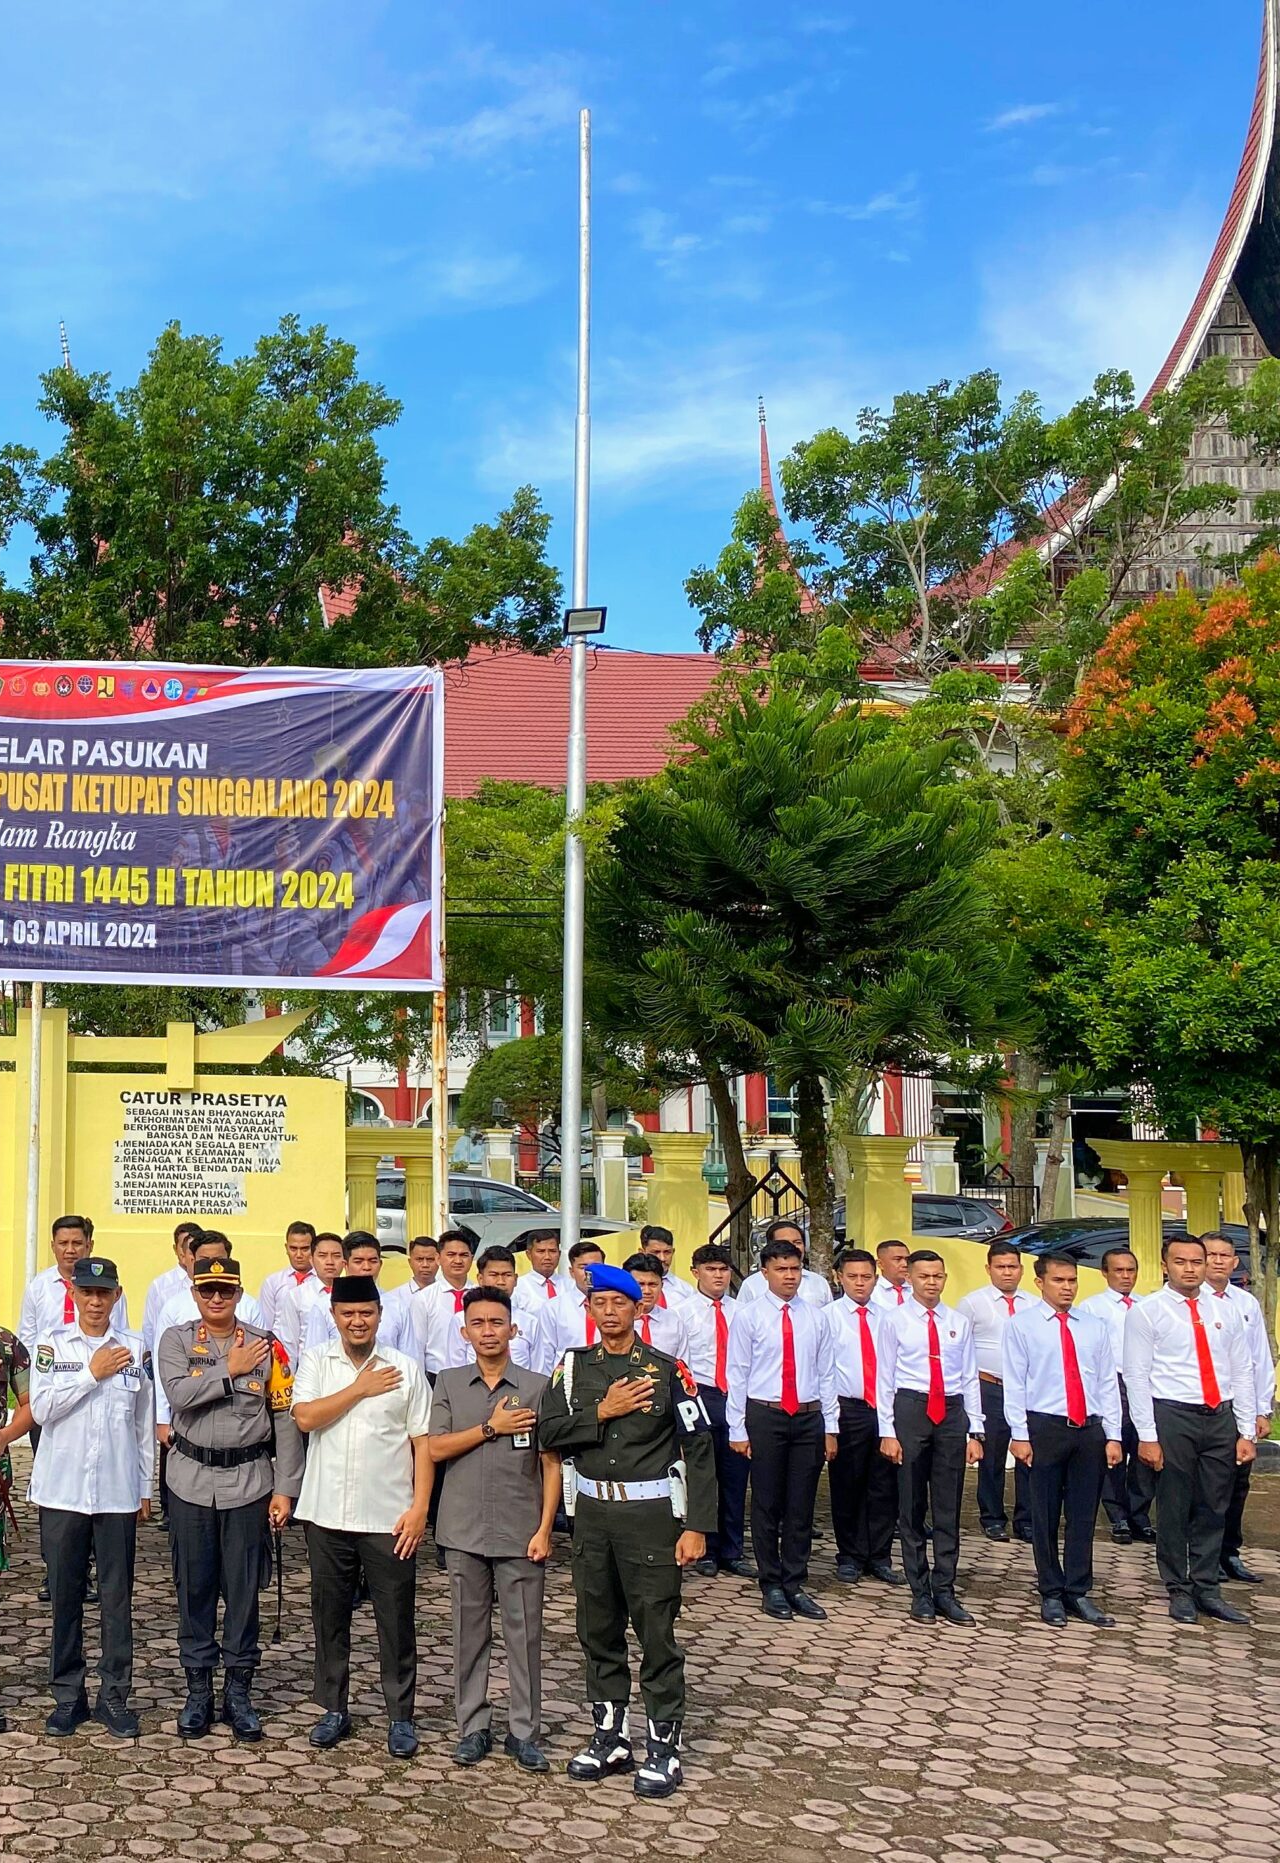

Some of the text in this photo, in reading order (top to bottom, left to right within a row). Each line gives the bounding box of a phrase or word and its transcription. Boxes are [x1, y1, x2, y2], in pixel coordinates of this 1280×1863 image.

[72, 740, 207, 768] PASUKAN
[72, 775, 172, 814] KETUPAT
[177, 777, 327, 817] SINGGALANG
[333, 779, 395, 818] 2024
[44, 821, 137, 857] Rangka
[4, 864, 74, 902] FITRI
[81, 866, 149, 905] 1445
[156, 869, 175, 906] H
[182, 869, 274, 908] TAHUN
[280, 871, 354, 909] 2024
[13, 920, 40, 944] 03
[44, 921, 101, 946] APRIL
[105, 923, 157, 948] 2024
[120, 1091, 288, 1107] CATUR PRASETYA
[126, 1108, 286, 1118] SEBAGAI INSAN BHAYANGKARA
[207, 1117, 232, 1125] SAYA
[235, 1118, 276, 1126] ADALAH
[124, 1124, 184, 1132] BERKORBAN
[215, 1126, 284, 1134] MASYARAKAT
[147, 1132, 189, 1140] BANGSA
[219, 1133, 260, 1141] NEGARA
[263, 1134, 298, 1142] UNTUK
[196, 1141, 236, 1149] SEGALA
[239, 1142, 273, 1150] BENT
[187, 1149, 245, 1157] KEAMANAN
[178, 1157, 252, 1165] KESELAMATAN
[124, 1164, 151, 1172] RAGA
[194, 1165, 228, 1173] BENDA
[124, 1172, 154, 1180] ASASI
[181, 1182, 238, 1190] KEPASTIA
[124, 1190, 199, 1198] BERDASARKAN
